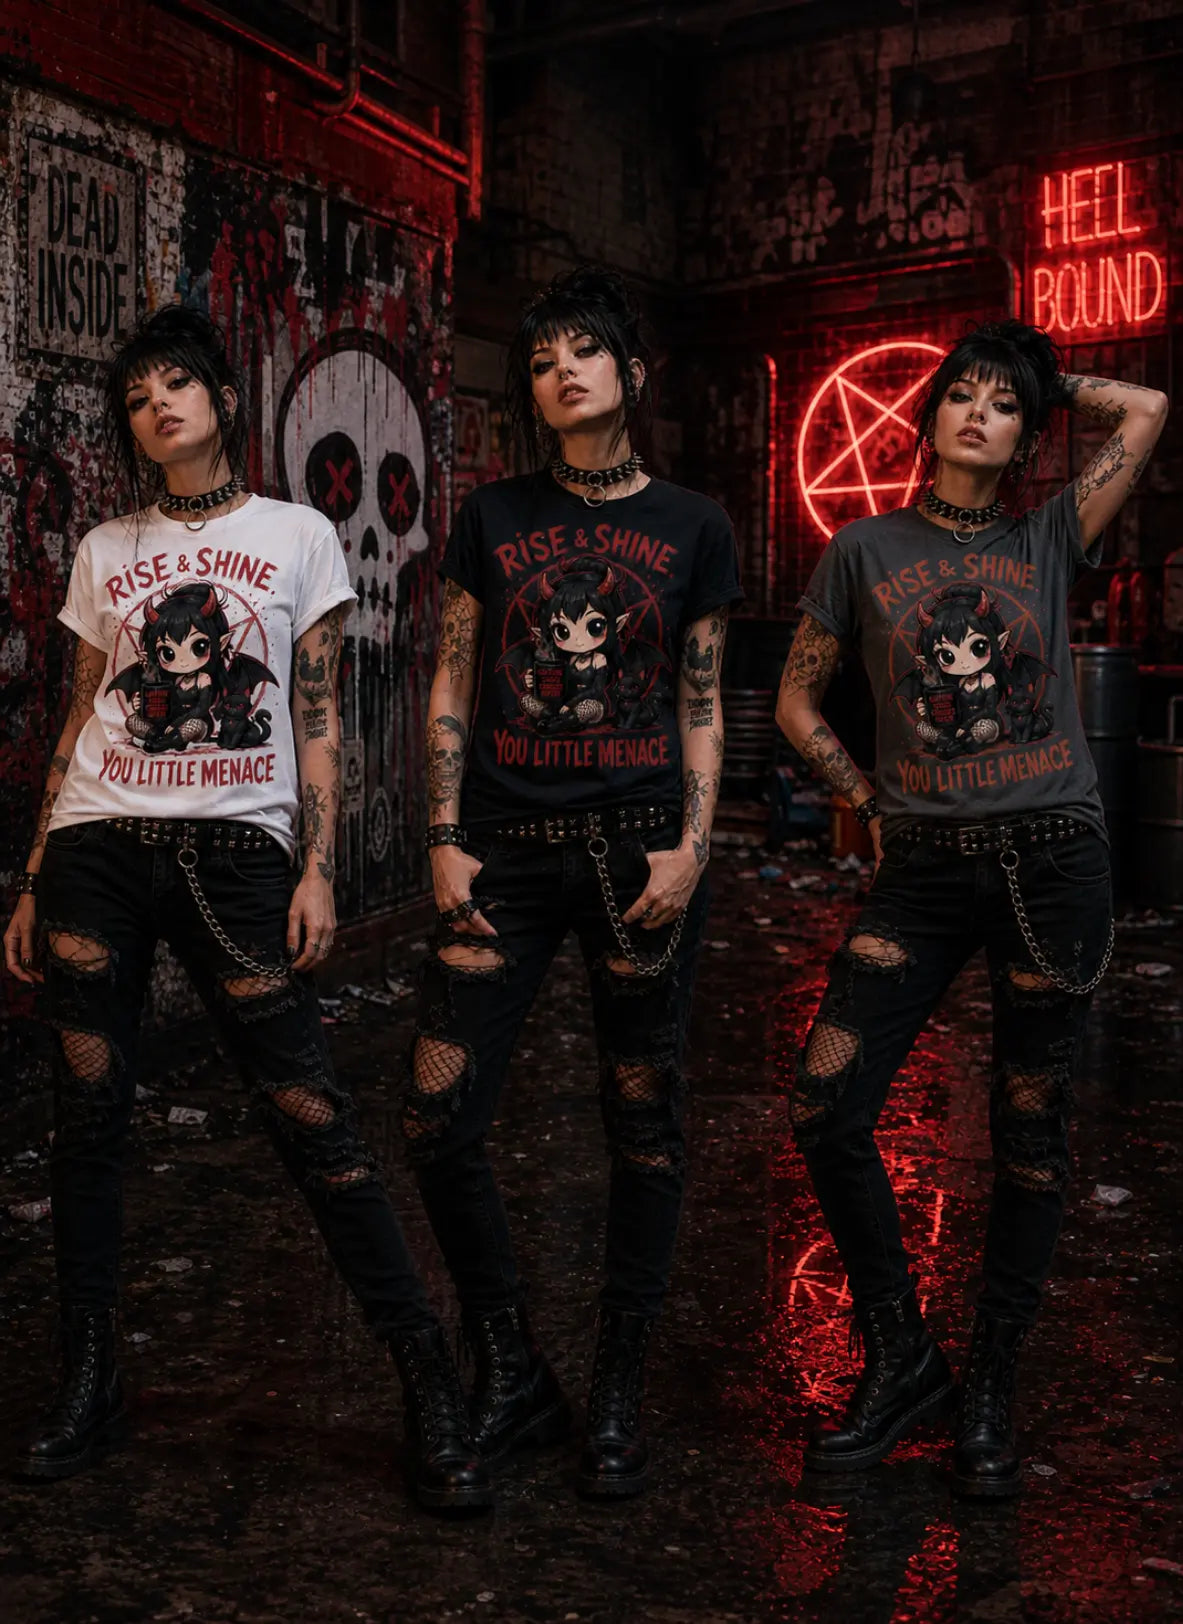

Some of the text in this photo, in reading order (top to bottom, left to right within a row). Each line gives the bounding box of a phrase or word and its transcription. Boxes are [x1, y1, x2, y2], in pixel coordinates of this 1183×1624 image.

[48, 165, 119, 254] DEAD
[38, 247, 128, 340] INSIDE
[1034, 251, 1162, 333] BOUND
[573, 528, 588, 548] &
[177, 554, 190, 573] &
[938, 559, 957, 577] &
[98, 748, 276, 788] YOU LITTLE MENACE
[493, 728, 670, 768] YOU LITTLE MENACE
[896, 739, 1073, 795] YOU LITTLE MENACE
